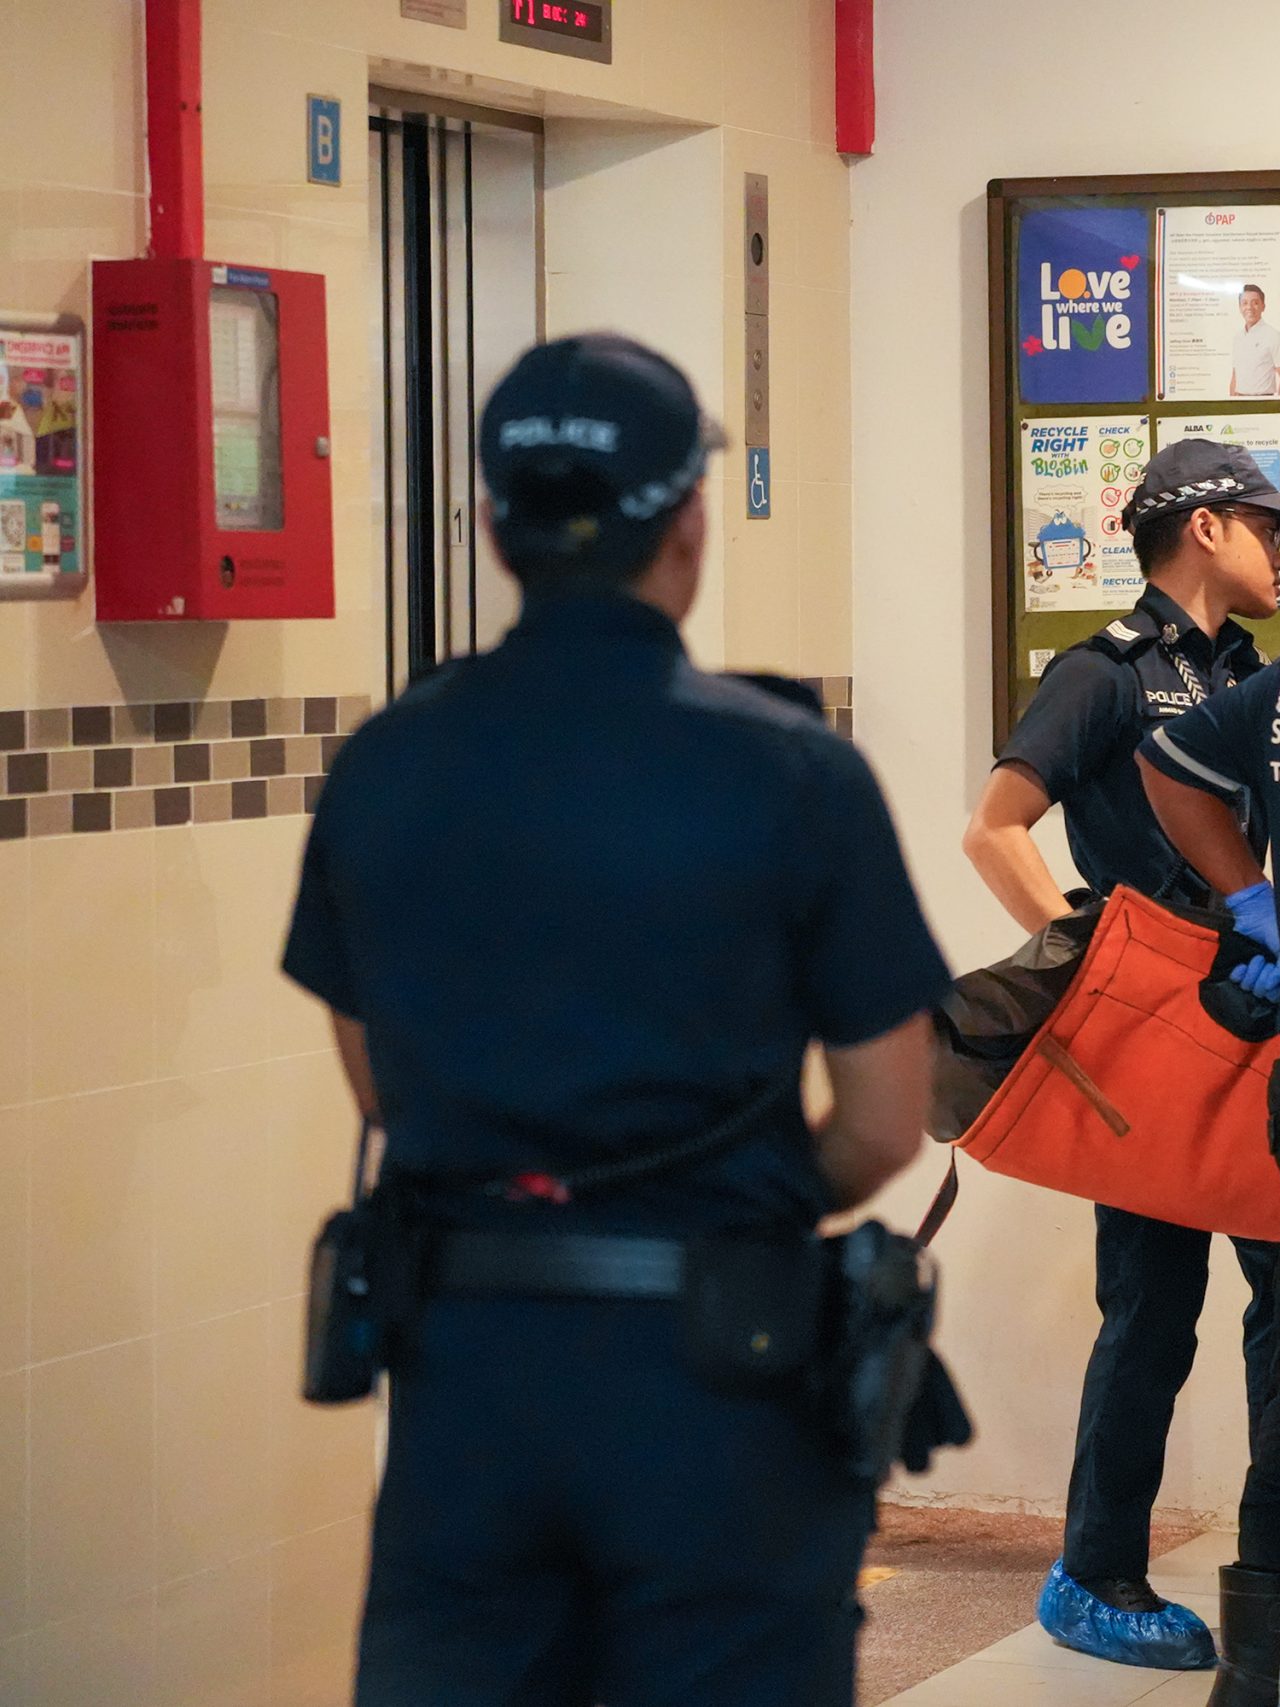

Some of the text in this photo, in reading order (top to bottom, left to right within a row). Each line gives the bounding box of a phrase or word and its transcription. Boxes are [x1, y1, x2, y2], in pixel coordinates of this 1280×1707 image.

[318, 115, 333, 165] B
[1216, 213, 1236, 225] PAP
[1041, 262, 1131, 301] Love
[1056, 301, 1123, 314] where we
[1042, 303, 1131, 351] live
[1030, 426, 1088, 437] RECYCLE
[1098, 427, 1130, 435] CHECK
[1184, 424, 1204, 432] ALBA
[1031, 437, 1089, 452] RIGHT
[1255, 438, 1279, 447] recycle
[454, 508, 462, 543] 1
[1102, 546, 1133, 554] CLEAN
[1102, 577, 1144, 586] RECYCLE
[1145, 690, 1193, 707] POLICE
